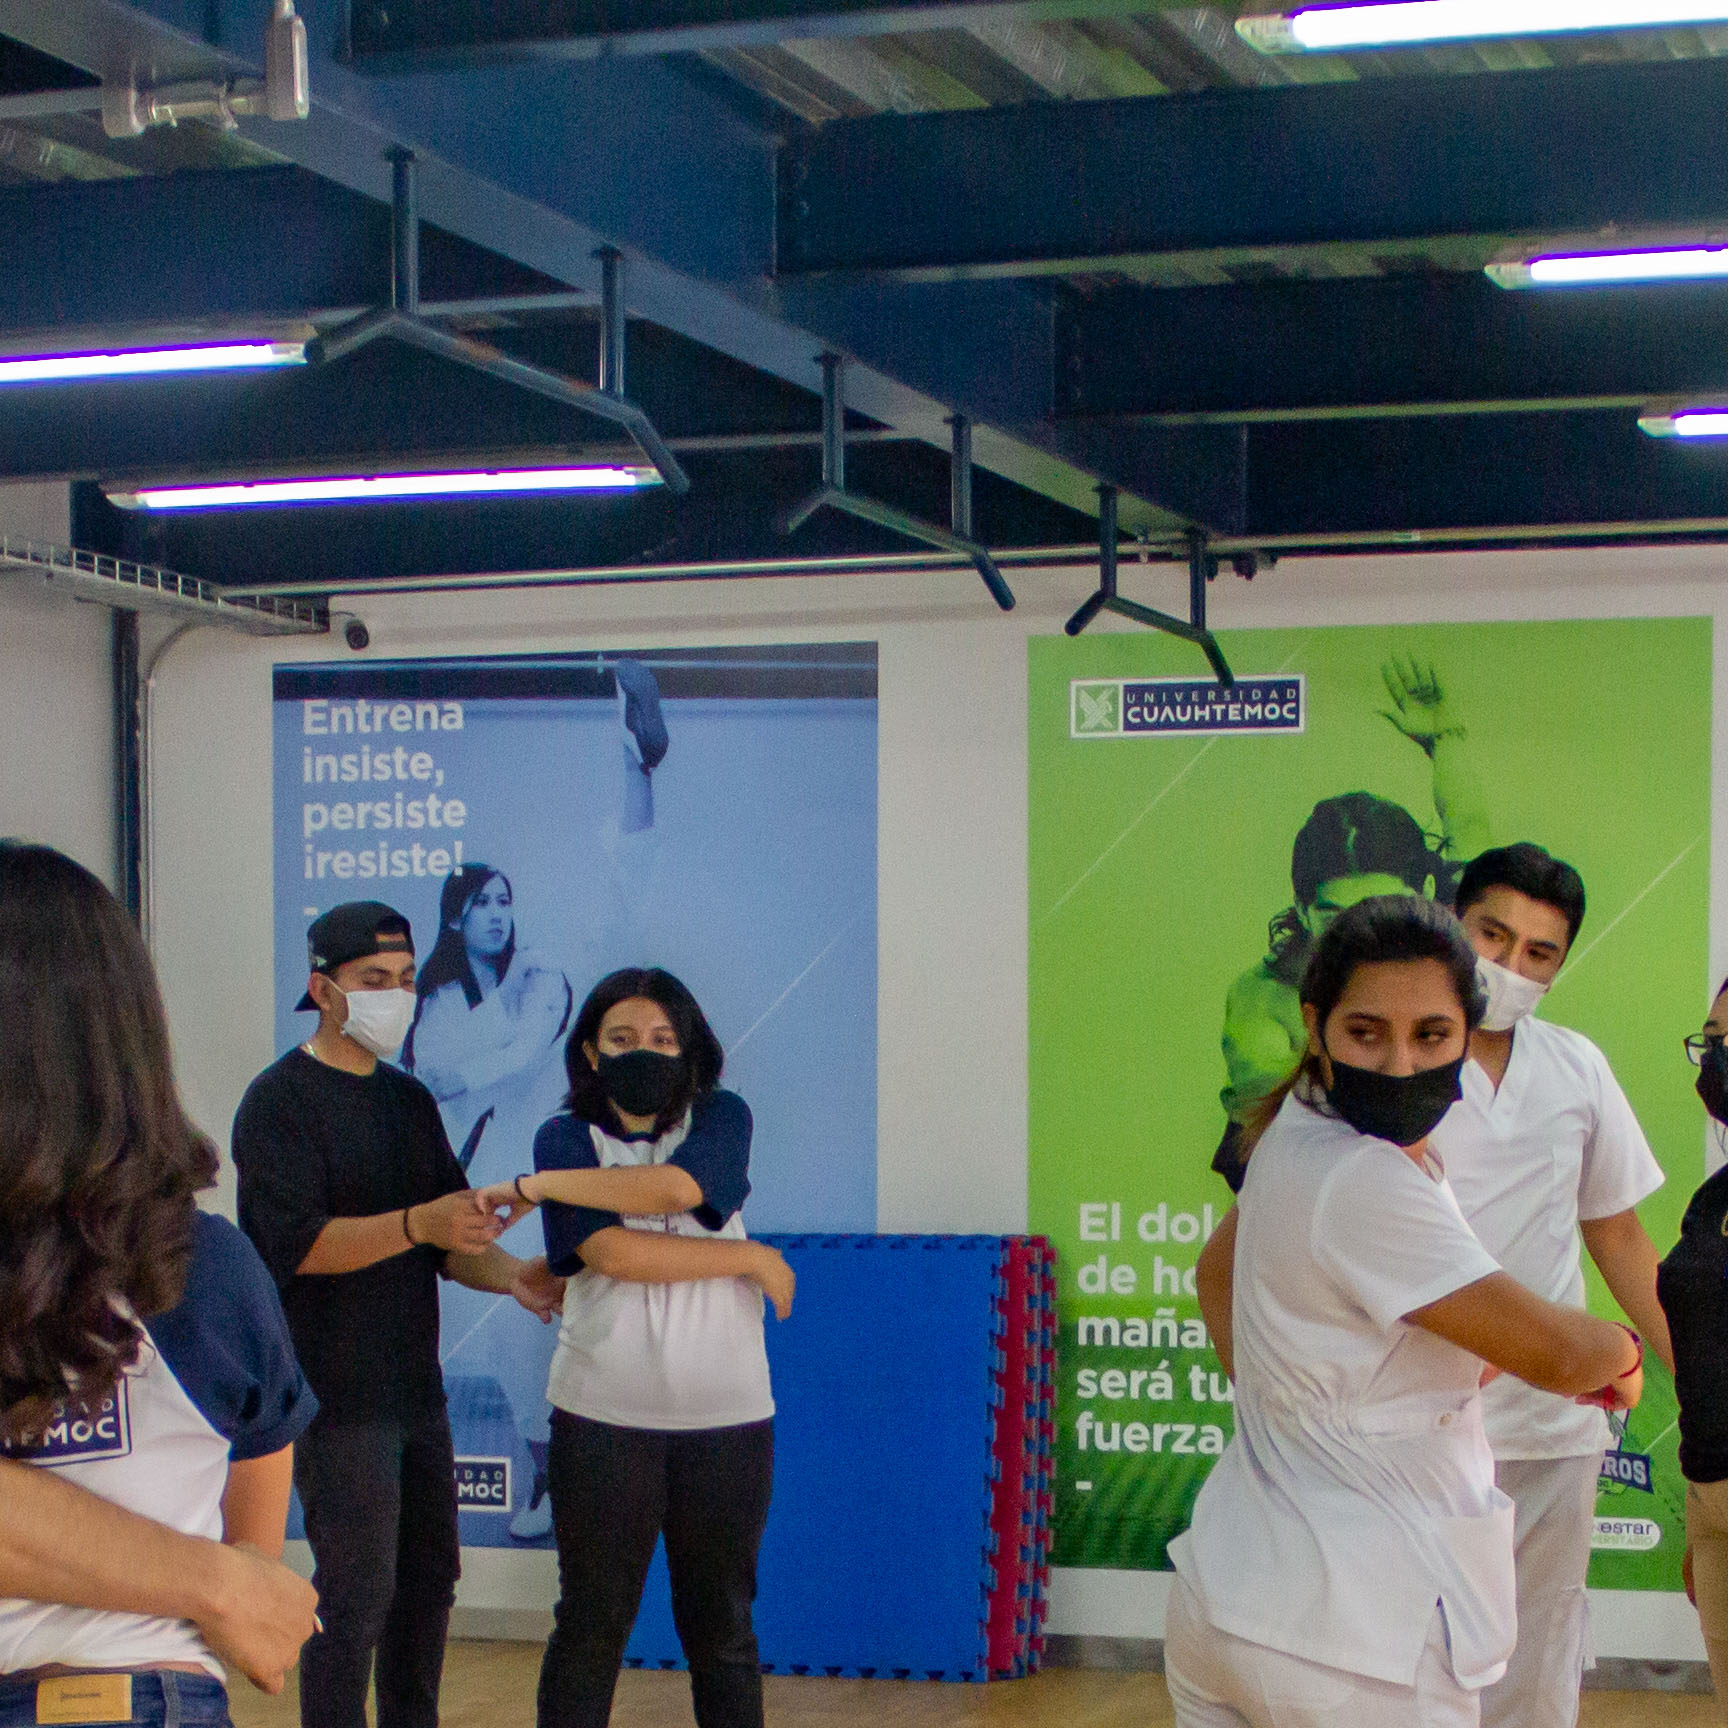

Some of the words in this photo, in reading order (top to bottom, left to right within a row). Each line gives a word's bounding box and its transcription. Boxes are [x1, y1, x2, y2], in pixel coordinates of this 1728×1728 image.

[1126, 688, 1296, 704] UNIVERSIDAD
[1127, 702, 1296, 724] CUAUHTEMOC
[303, 699, 464, 735] Entrena
[303, 745, 444, 787] insiste,
[303, 792, 466, 838] persiste
[1080, 1203, 1120, 1241] El
[1138, 1202, 1222, 1243] dol
[1077, 1255, 1137, 1294] de
[1078, 1308, 1215, 1348] maña
[1077, 1359, 1173, 1400] será
[1189, 1365, 1235, 1401] tu
[1076, 1411, 1223, 1454] fuerza
[457, 1482, 503, 1499] MOC
